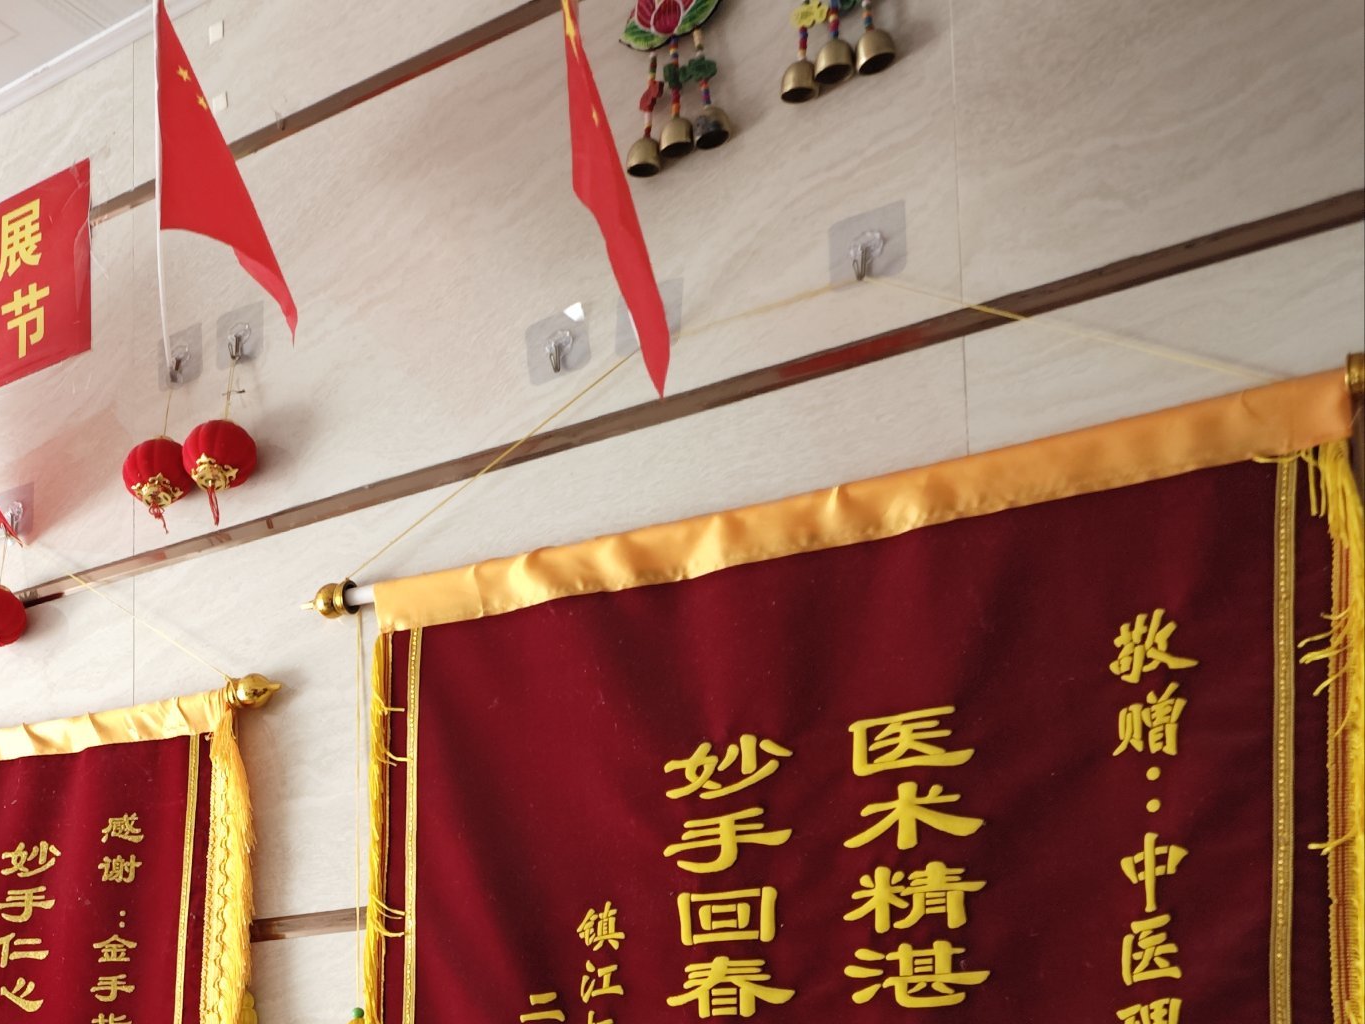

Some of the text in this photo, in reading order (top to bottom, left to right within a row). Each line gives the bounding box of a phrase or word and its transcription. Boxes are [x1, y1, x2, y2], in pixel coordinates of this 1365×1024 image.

[663, 735, 794, 1018] 妙手回春
[843, 707, 989, 1007] 医术精湛
